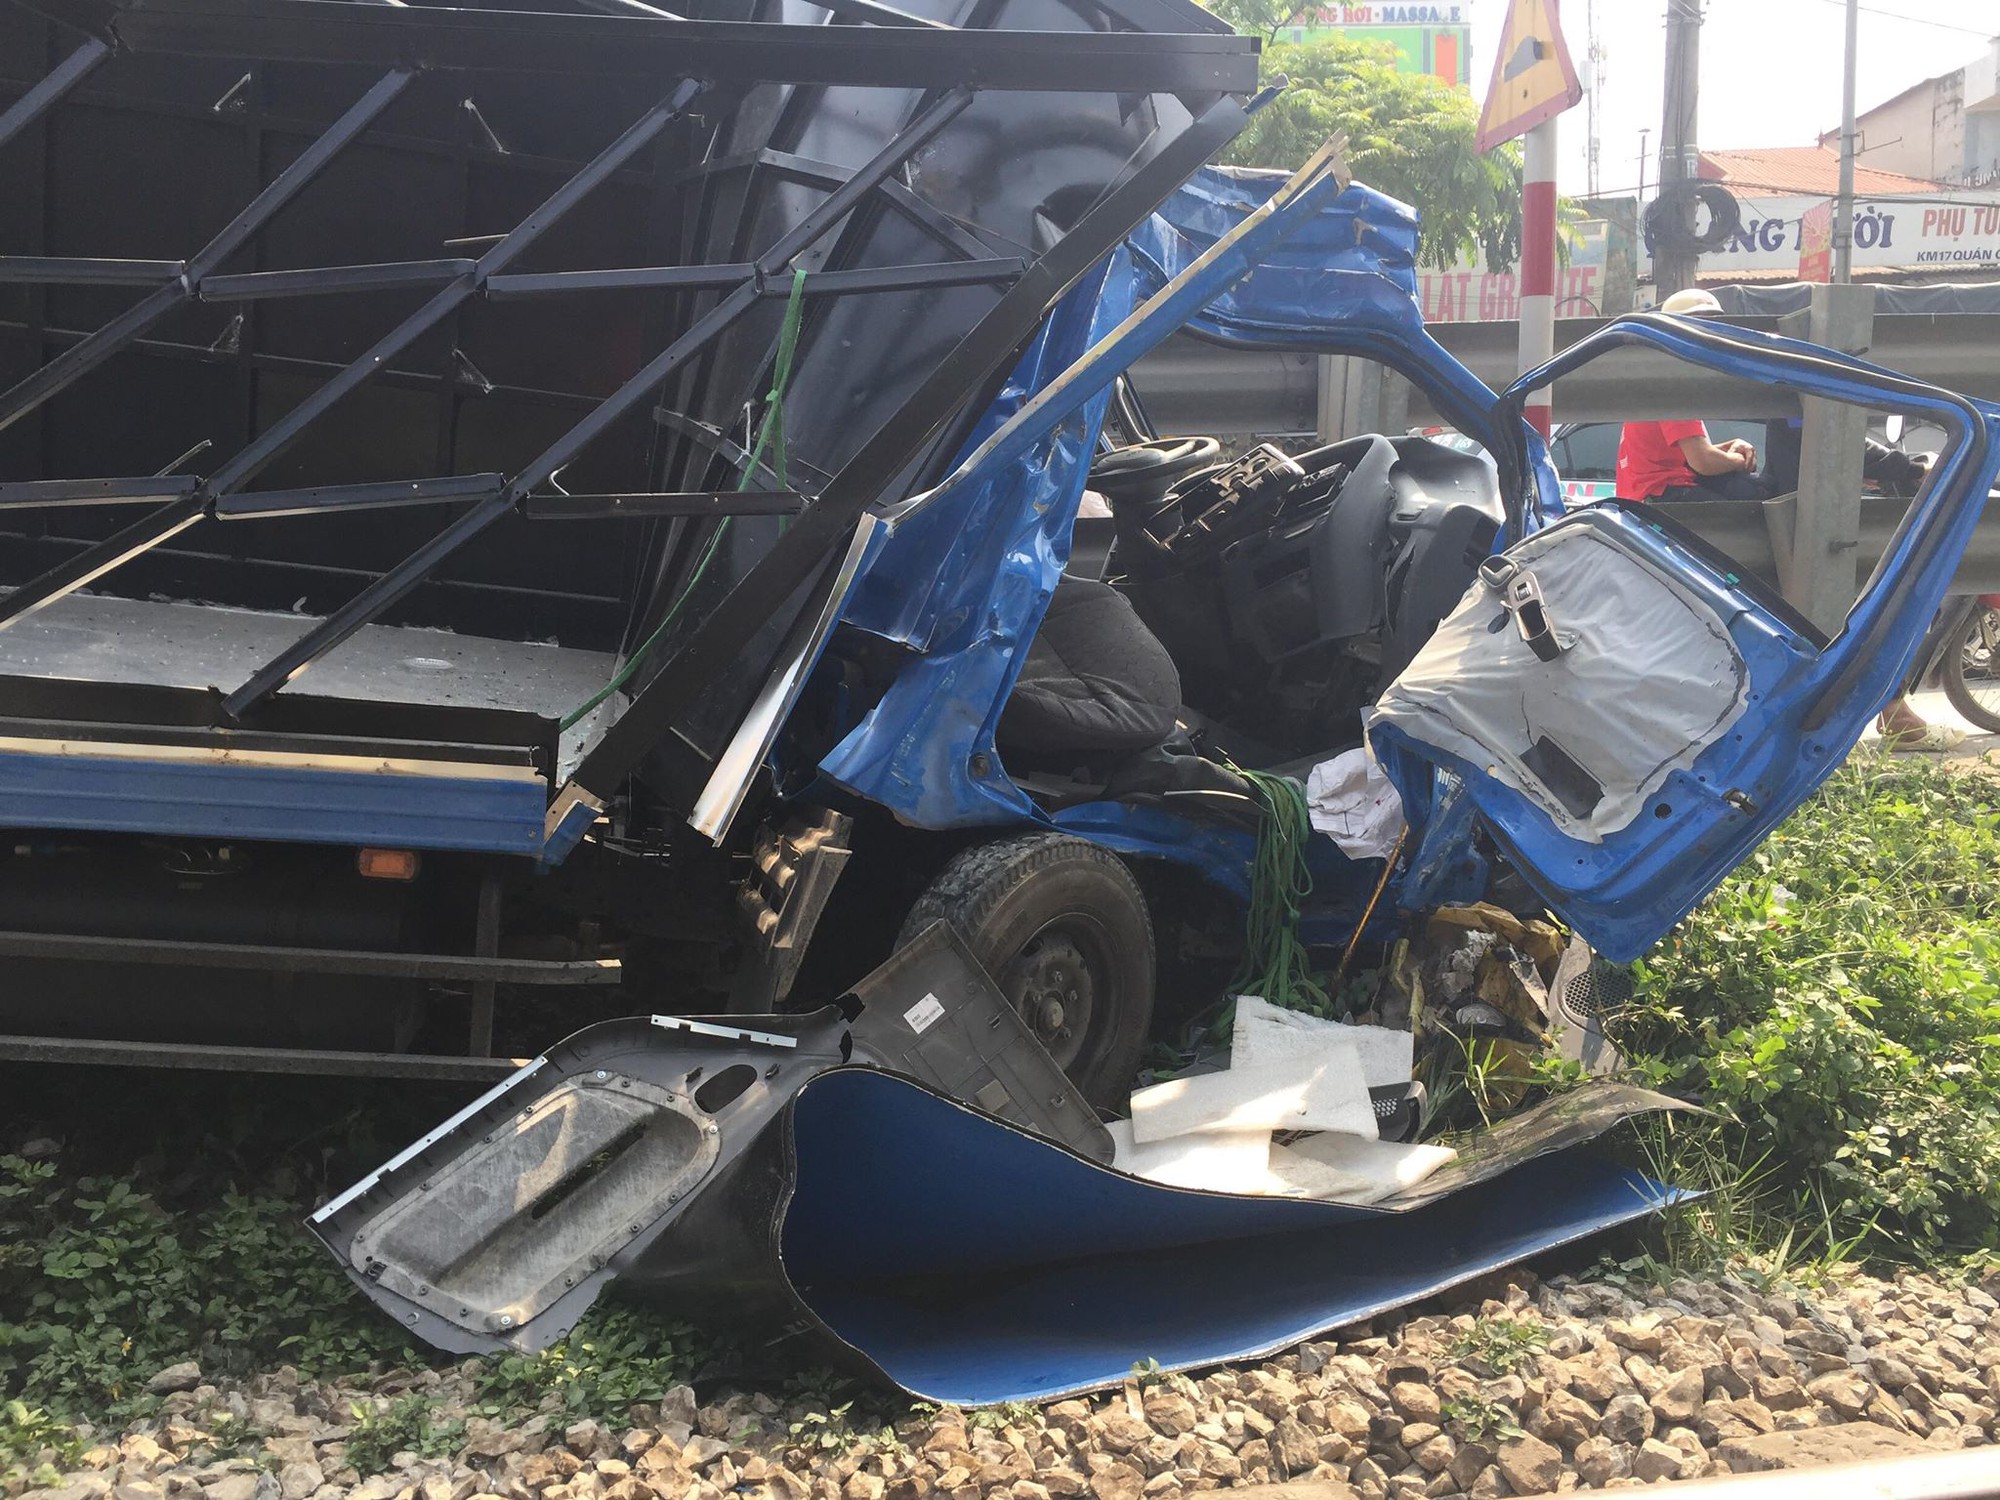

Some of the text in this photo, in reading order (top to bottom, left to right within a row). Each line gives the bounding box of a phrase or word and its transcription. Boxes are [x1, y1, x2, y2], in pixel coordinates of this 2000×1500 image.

[1382, 6, 1461, 22] MASSAE
[1922, 208, 1967, 241] PHỤ
[1479, 266, 1597, 320] GRITE
